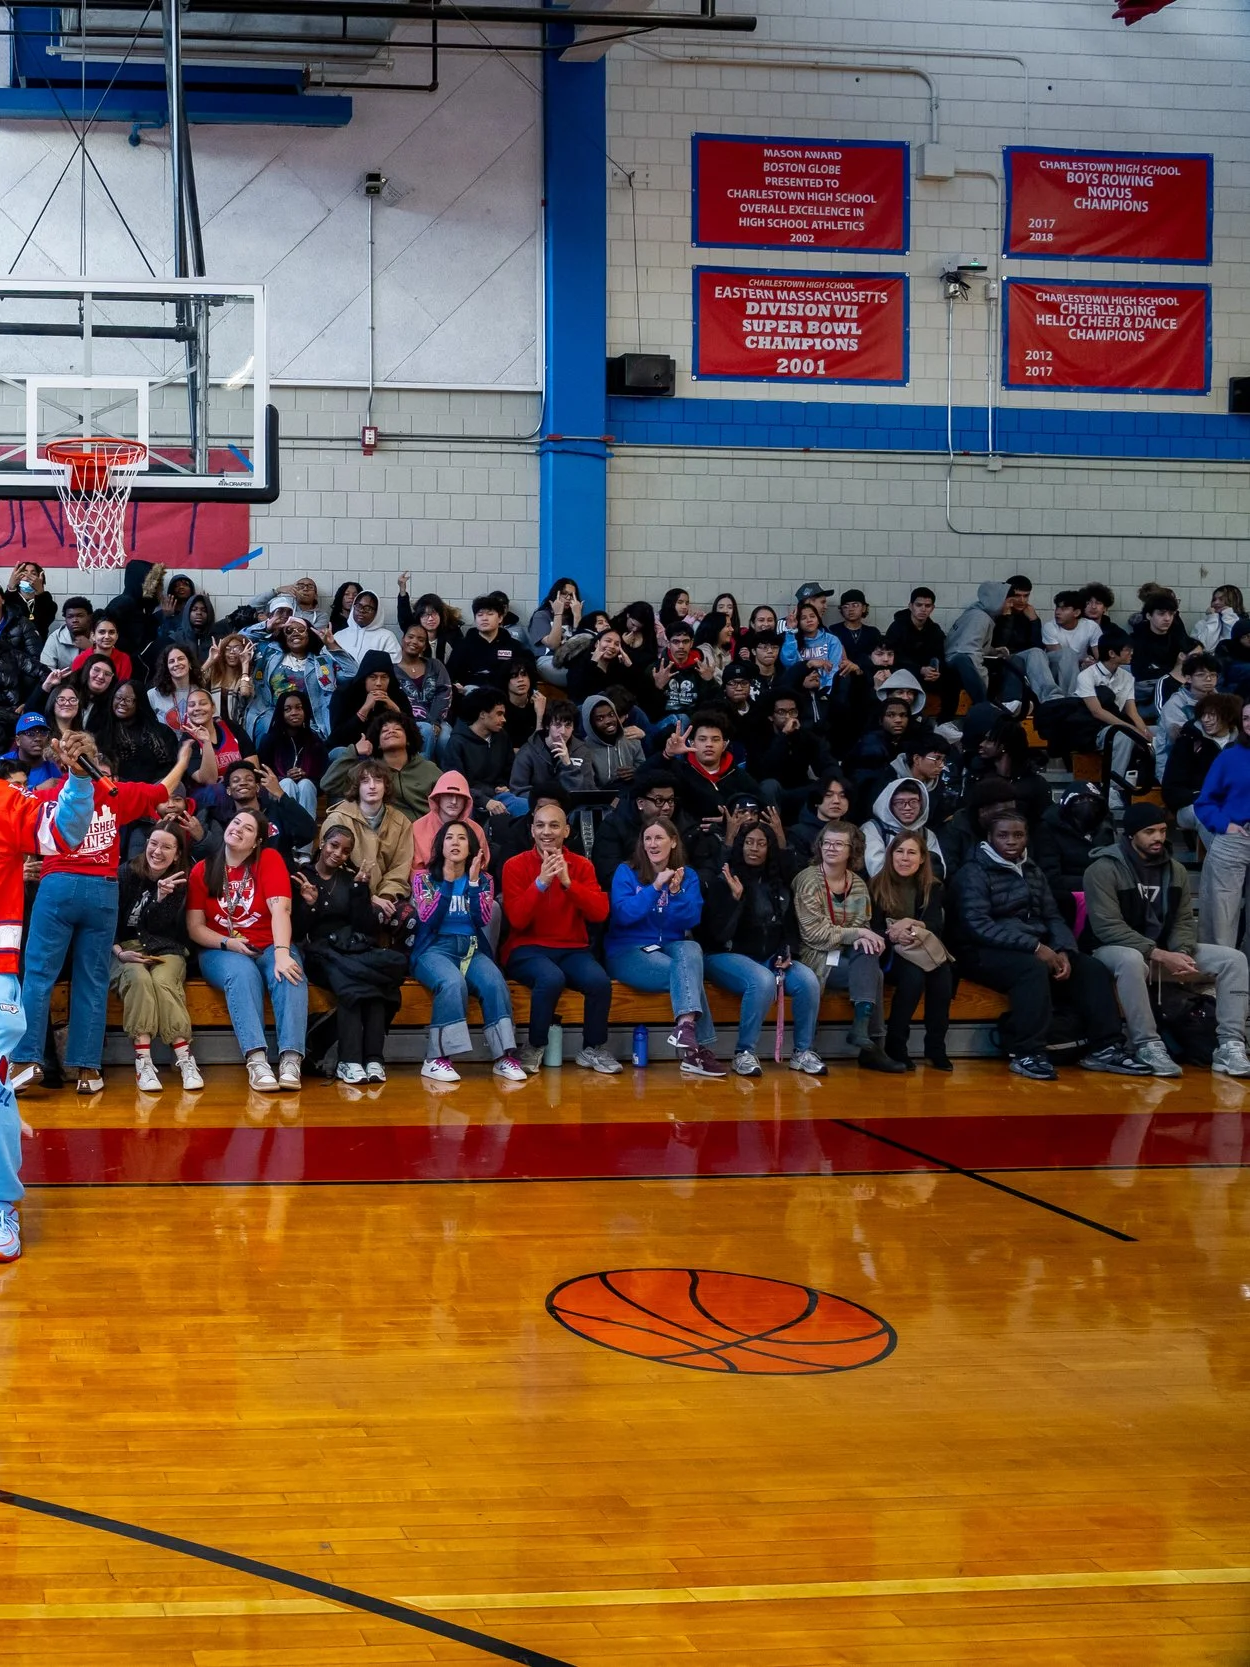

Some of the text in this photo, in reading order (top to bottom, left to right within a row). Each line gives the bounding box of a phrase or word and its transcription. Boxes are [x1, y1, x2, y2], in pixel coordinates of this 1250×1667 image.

[764, 149, 842, 160] MASON AWARD
[763, 162, 841, 175] BOSTON GLOBE
[1040, 161, 1181, 176] CHARLESTOWN HIGH SCHOOL
[765, 177, 839, 188] PRESENTED TO
[1066, 172, 1153, 187] BOYS ROWING
[727, 189, 877, 204] CHARLESTOWN HIGH SCHOOL
[1088, 186, 1132, 199] NOVUS
[740, 204, 864, 217] OVERALL EXCELLENCE IN
[1074, 198, 1149, 213] CHAMPIONS
[739, 218, 865, 231] HIGH SCHOOL ATHLETICS
[1028, 218, 1055, 229] 2017
[790, 233, 815, 243] 2002
[1029, 232, 1054, 242] 2018
[749, 279, 855, 290] CHARLESTOWN HIGH SCHOOL
[714, 287, 888, 304] EASTERN MASSACHUSETTS
[1036, 292, 1180, 306] CHARLESTOWN HIGH SCHOOL
[746, 302, 859, 319] DIVISION VII
[1060, 303, 1156, 316] CHEERLEADING
[743, 320, 862, 335] SUPER BOWL
[1036, 315, 1178, 330] HELLO CHEER & DANCE
[1068, 329, 1145, 342] CHAMPIONS
[745, 336, 859, 351] CHAMPIONS
[1025, 350, 1053, 361] 2012
[777, 358, 826, 374] 2001
[1025, 366, 1053, 377] 2017
